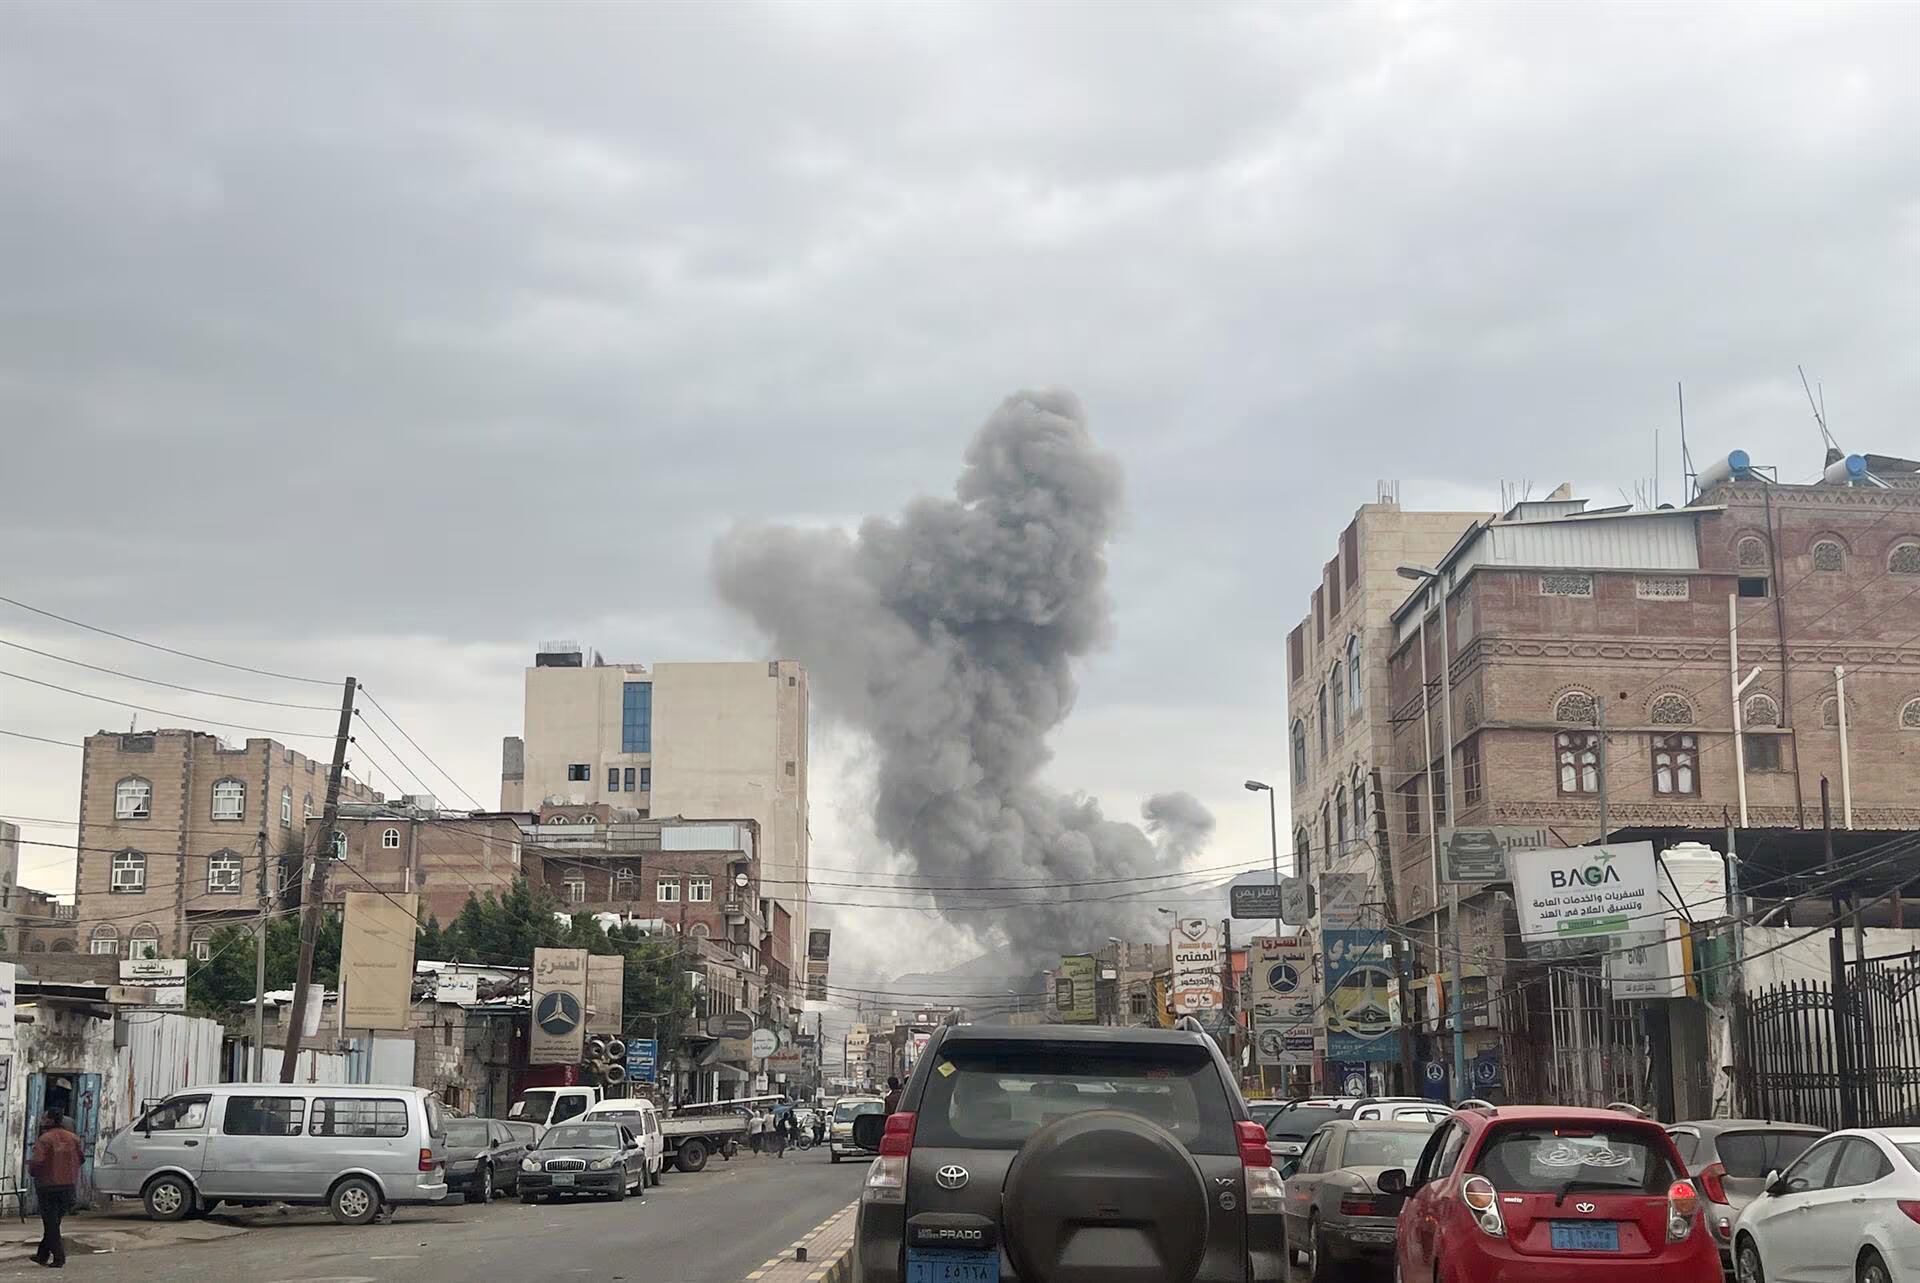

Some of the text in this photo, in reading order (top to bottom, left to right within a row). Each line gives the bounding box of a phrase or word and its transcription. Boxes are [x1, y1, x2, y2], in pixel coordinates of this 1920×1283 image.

[1551, 865, 1620, 888] BAGA
[1563, 894, 1603, 906] والخدمات
[1604, 888, 1645, 900] للسفريات
[1580, 907, 1605, 917] العلاج
[1607, 901, 1642, 914] وتنسيق
[1540, 911, 1561, 919] الهند
[1176, 950, 1217, 964] المفتي
[1215, 1177, 1236, 1187] VX
[940, 1229, 982, 1239] PRADO
